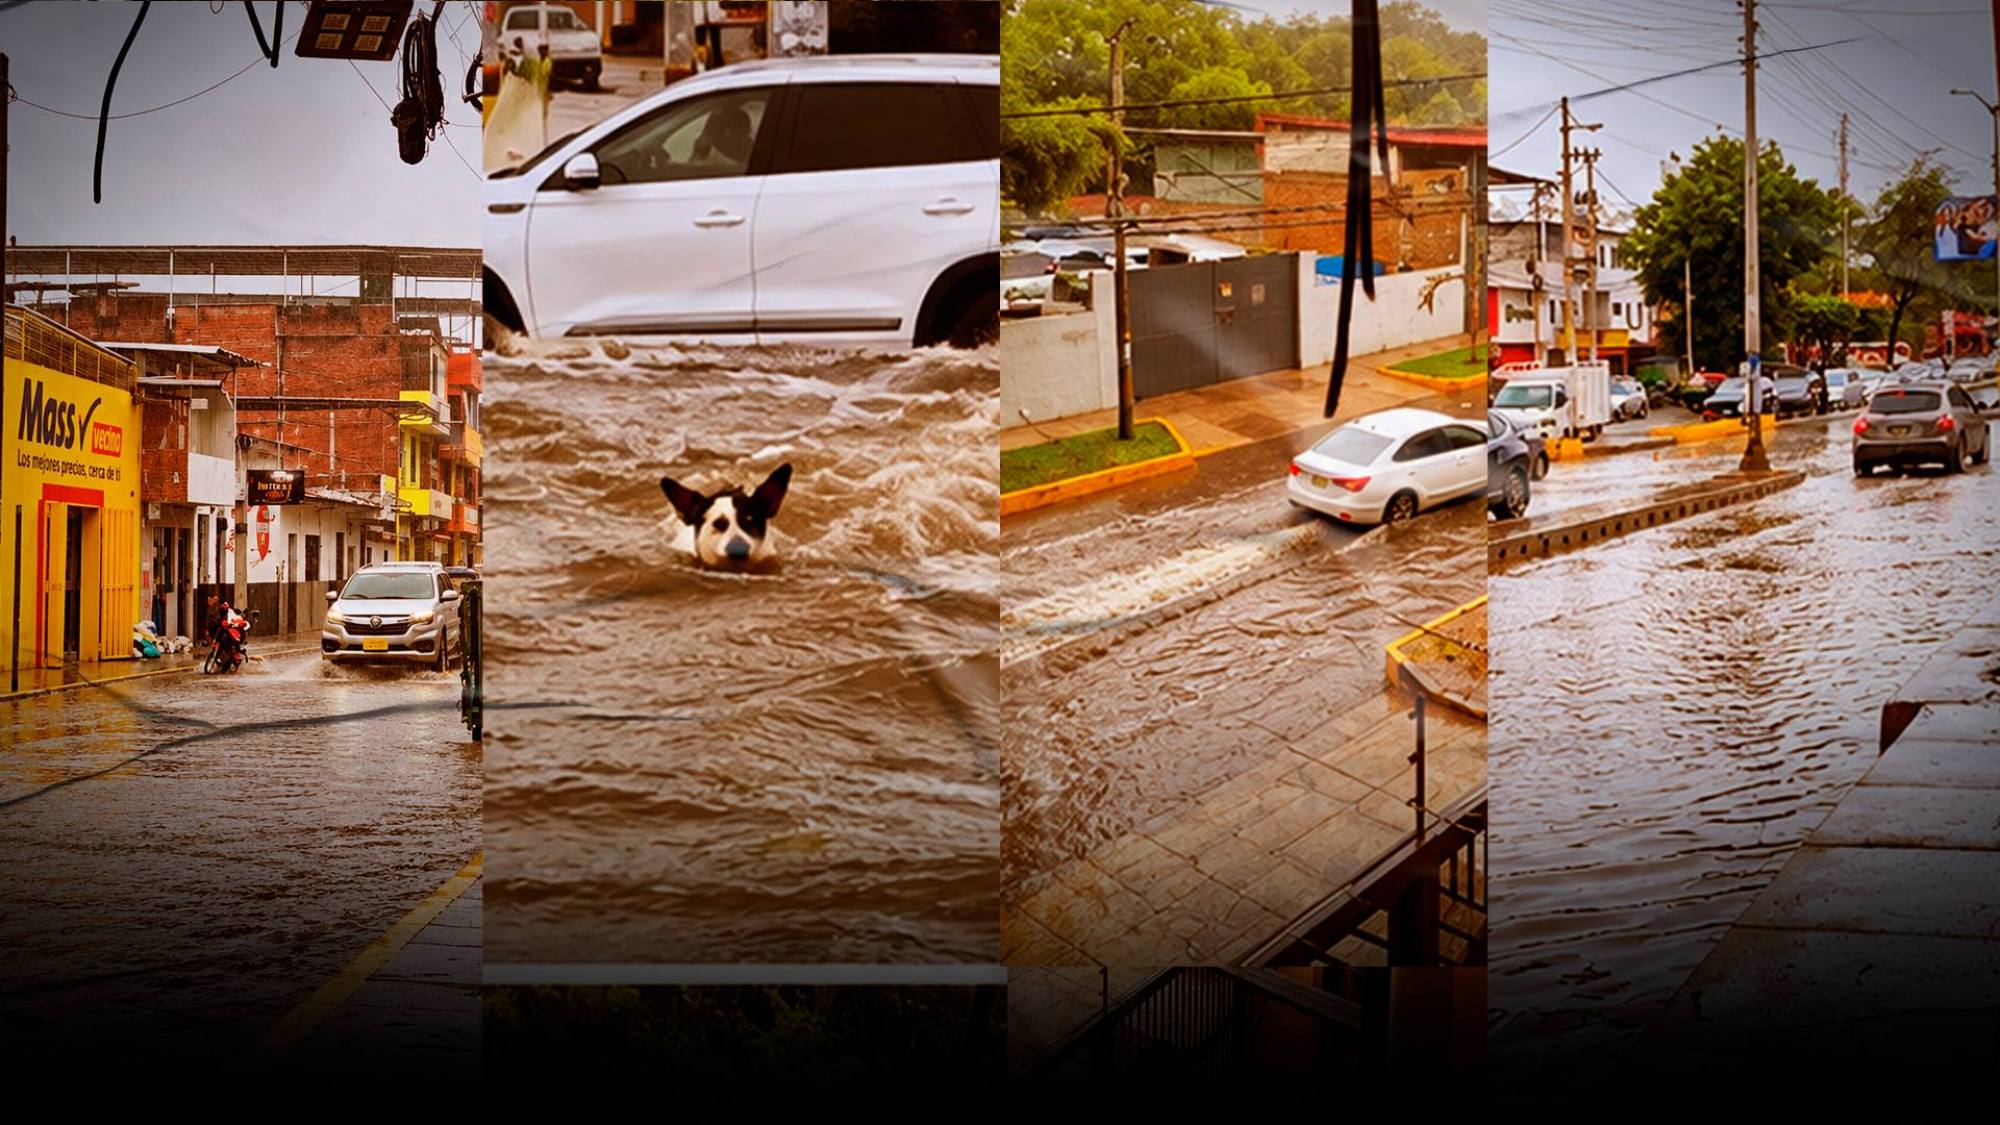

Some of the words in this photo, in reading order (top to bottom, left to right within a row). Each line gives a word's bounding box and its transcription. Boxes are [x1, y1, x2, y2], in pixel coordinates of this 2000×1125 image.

[18, 377, 75, 449] Mass
[94, 427, 120, 453] vecino
[17, 448, 31, 468] Los
[32, 453, 60, 475] mejores
[61, 460, 87, 479] precios,
[89, 464, 105, 479] cerca
[106, 465, 115, 481] de
[115, 466, 121, 481] ti
